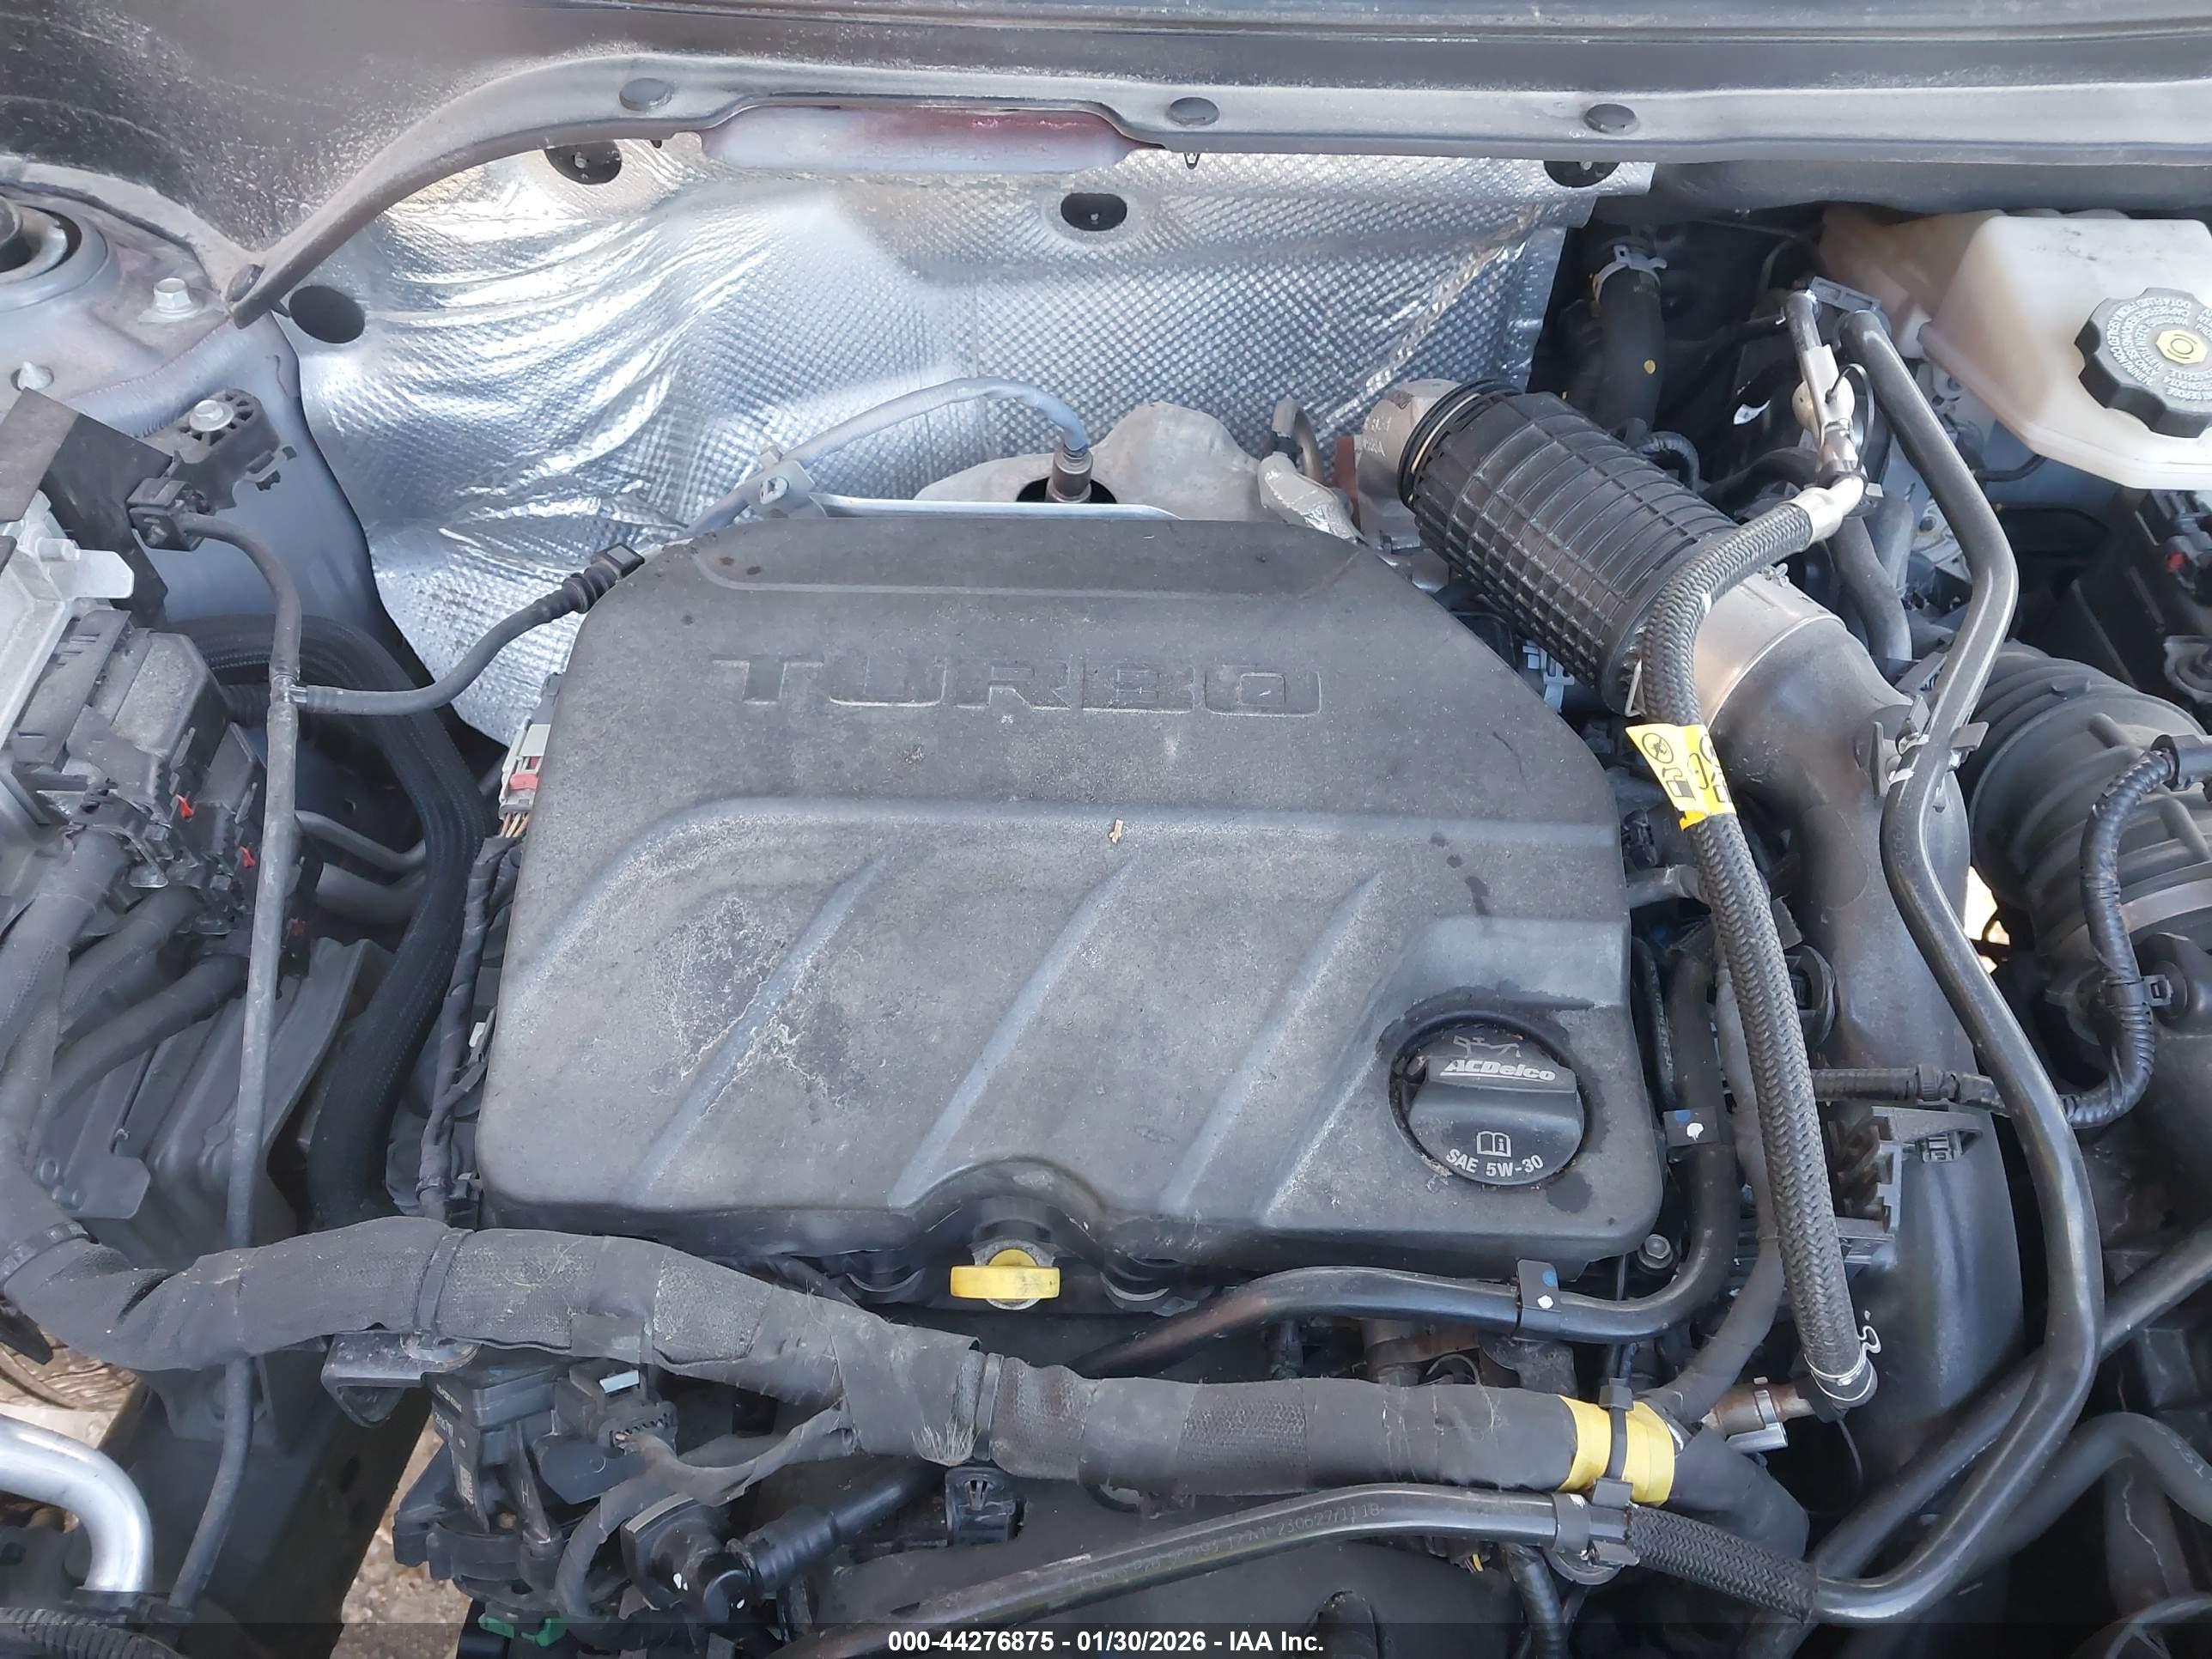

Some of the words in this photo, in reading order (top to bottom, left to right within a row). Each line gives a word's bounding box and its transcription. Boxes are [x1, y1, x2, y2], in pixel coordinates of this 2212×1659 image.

[2136, 359, 2160, 376] ONLY
[710, 655, 1322, 717] TURBO
[1443, 1059, 1556, 1081] ACDelco
[1446, 1148, 1479, 1173] SAE
[1486, 1154, 1544, 1176] 5W-30
